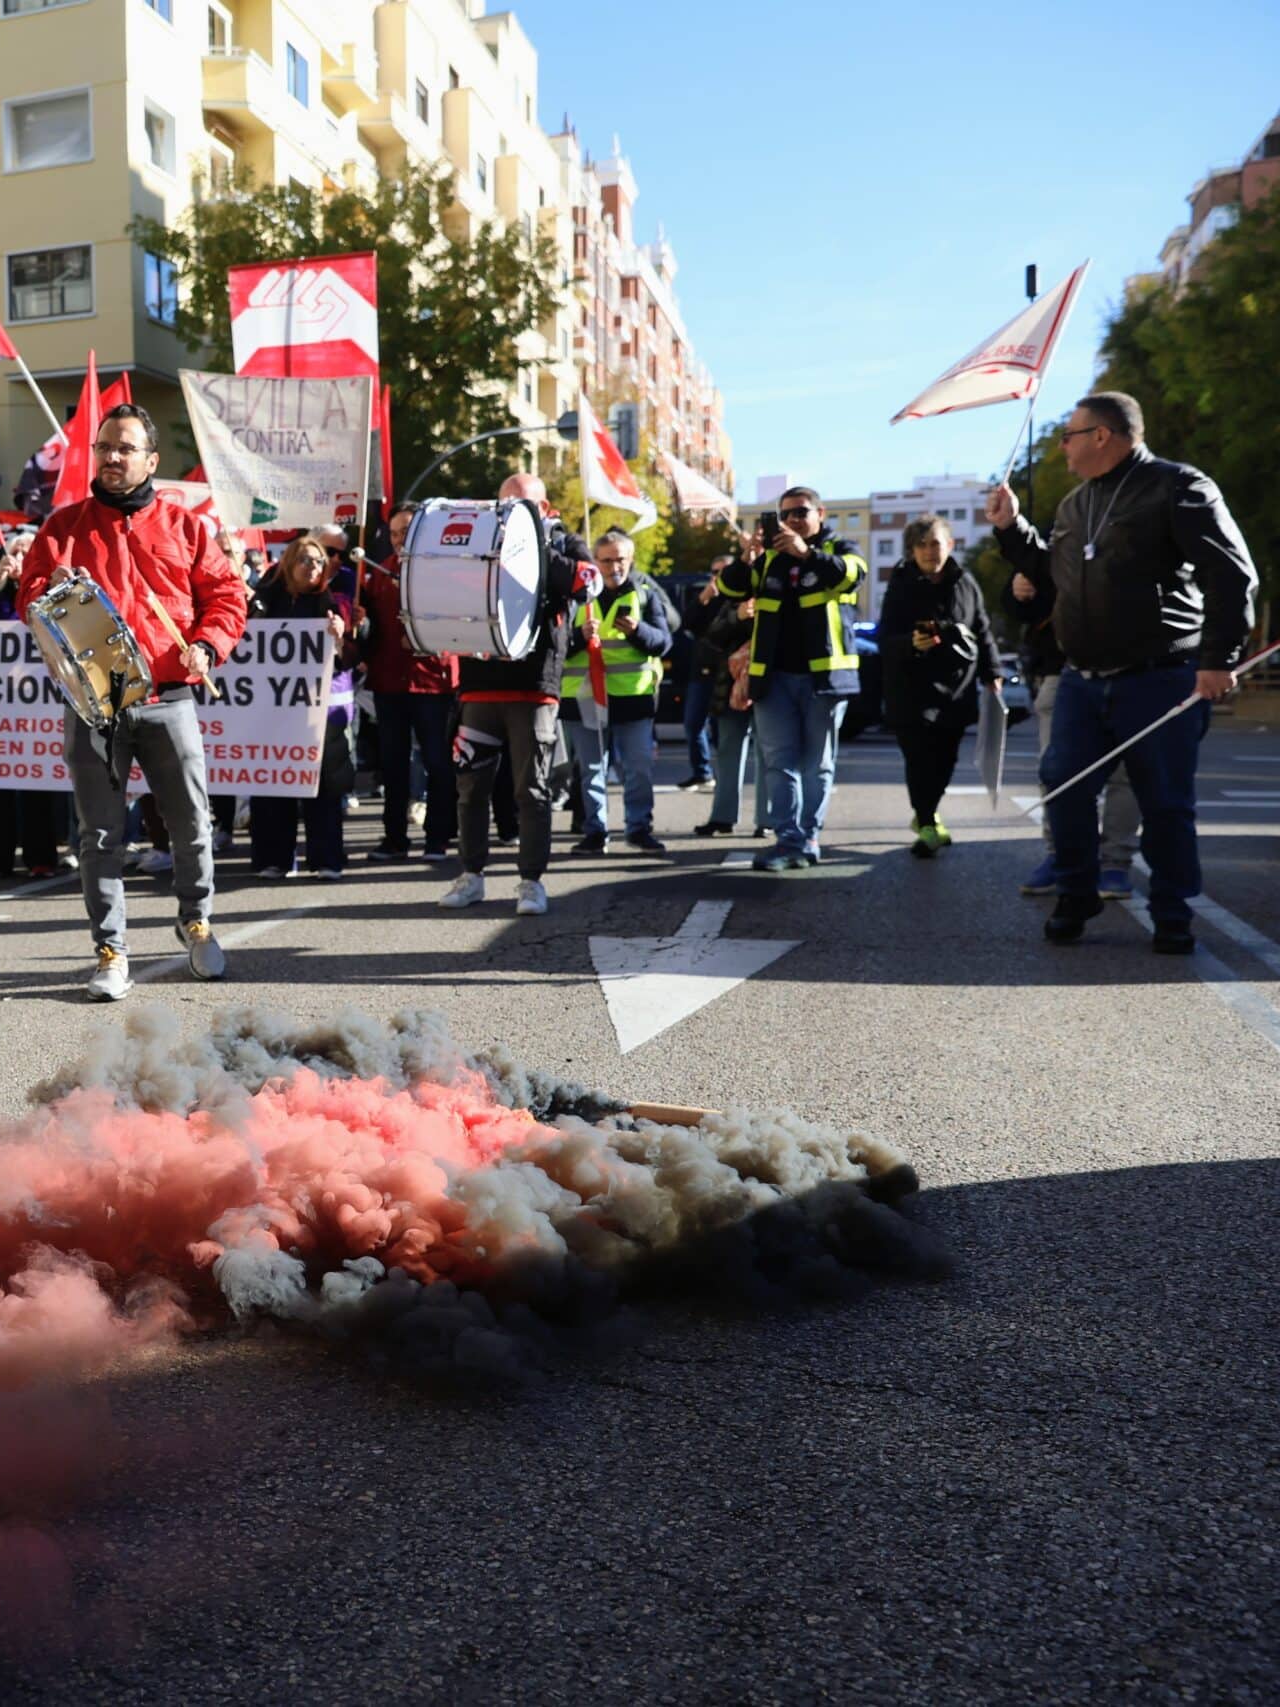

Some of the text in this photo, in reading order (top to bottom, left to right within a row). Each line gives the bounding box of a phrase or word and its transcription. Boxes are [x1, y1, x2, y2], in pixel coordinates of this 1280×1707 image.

[232, 428, 314, 455] CONTRA
[442, 533, 470, 545] CGT
[267, 676, 322, 707] YA!
